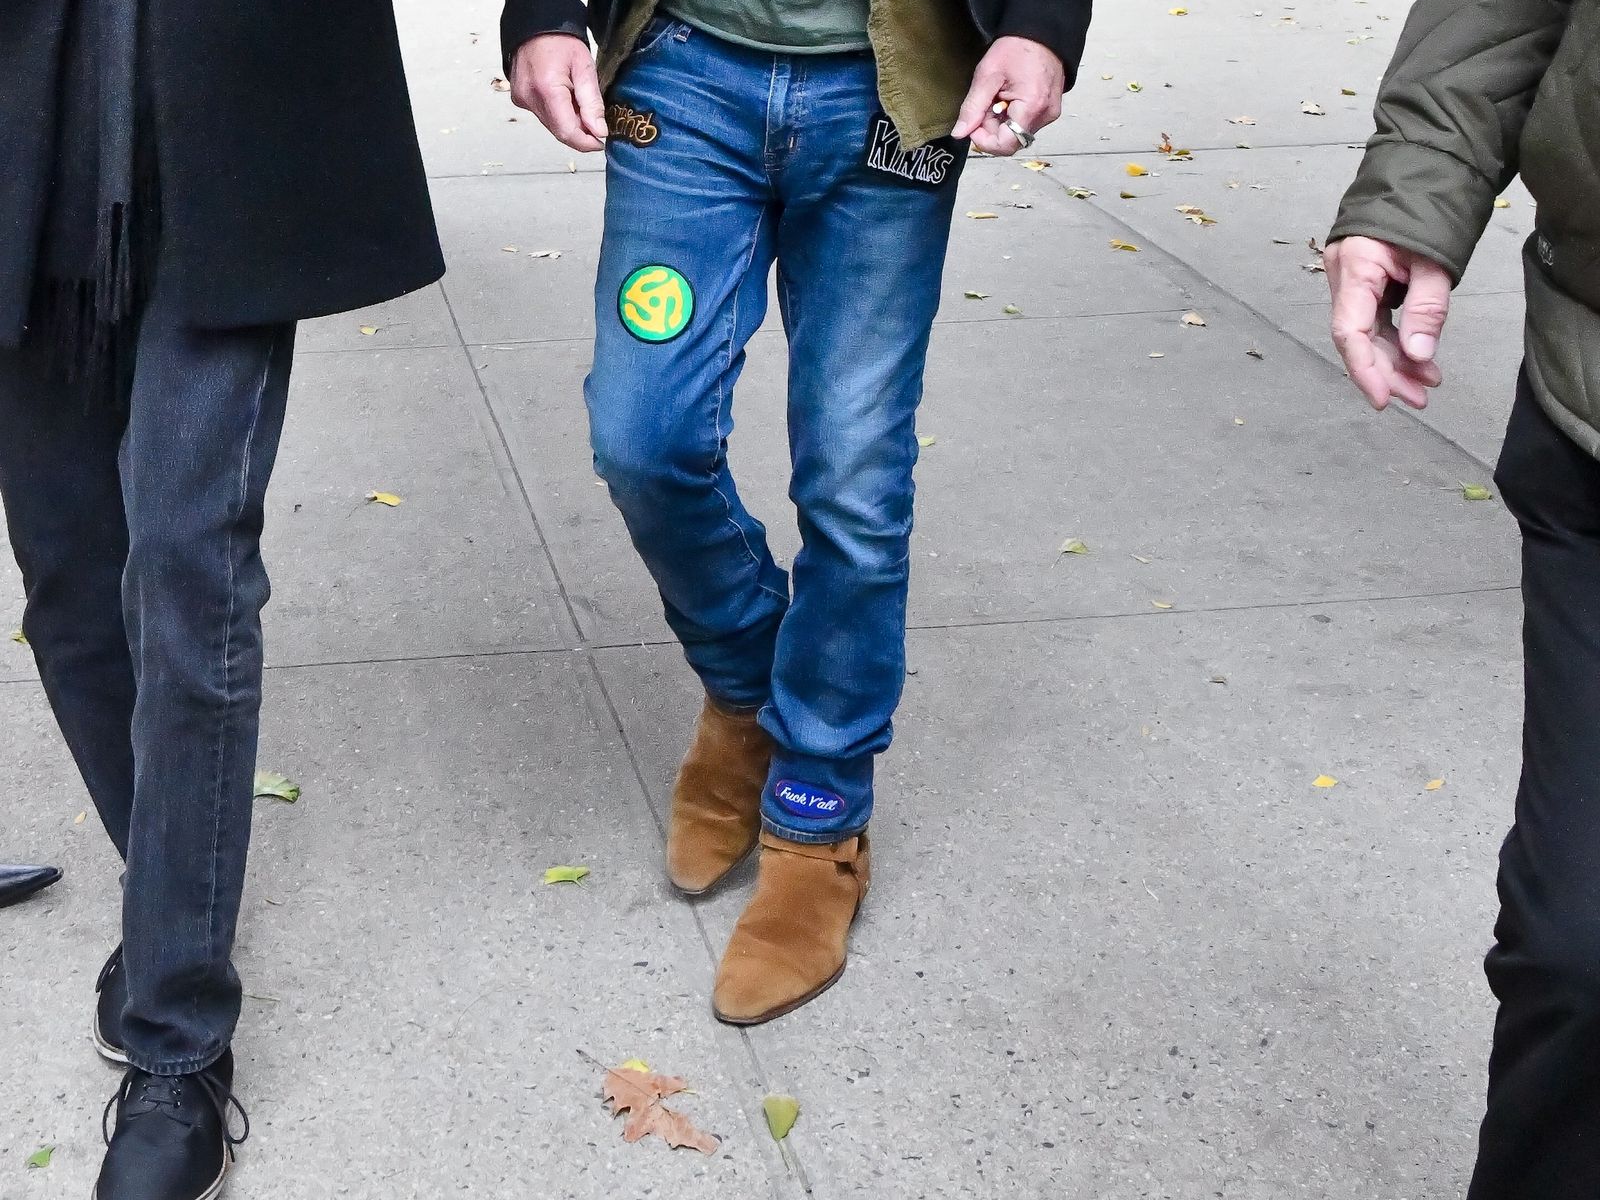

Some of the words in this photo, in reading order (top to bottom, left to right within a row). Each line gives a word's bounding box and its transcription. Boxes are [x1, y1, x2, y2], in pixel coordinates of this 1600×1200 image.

[867, 119, 955, 184] KINKS
[780, 786, 807, 806] Fuck
[808, 795, 838, 811] Y'all
